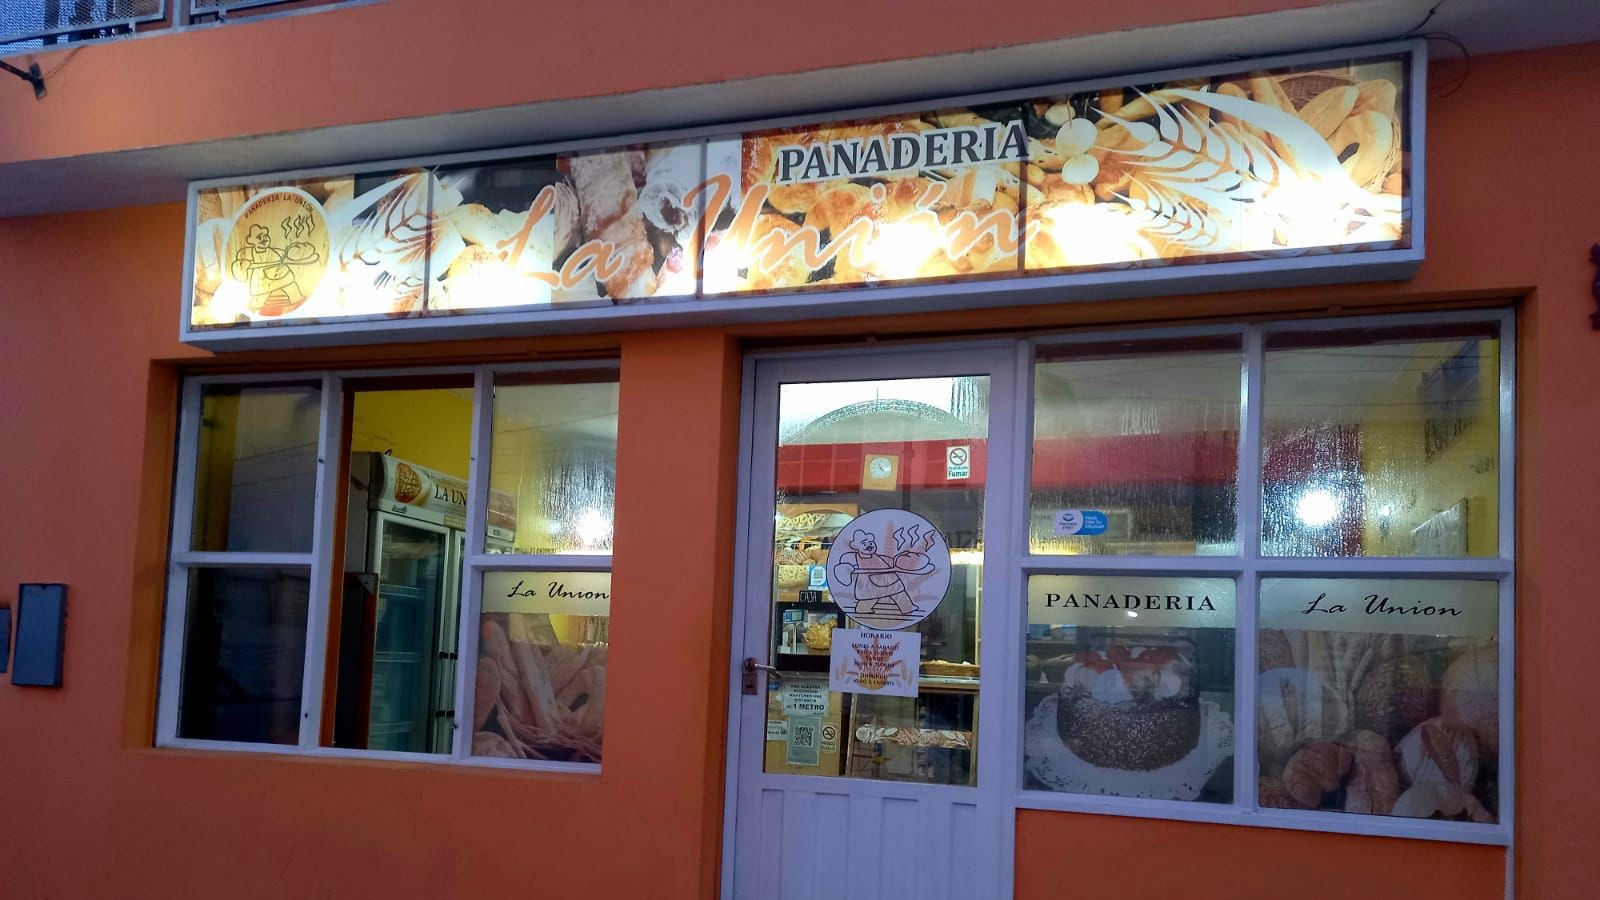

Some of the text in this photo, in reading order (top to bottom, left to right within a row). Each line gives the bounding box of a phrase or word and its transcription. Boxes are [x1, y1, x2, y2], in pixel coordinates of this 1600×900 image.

[780, 121, 1029, 182] PANADERIA
[283, 193, 292, 201] LA
[496, 185, 624, 288] La
[435, 484, 448, 502] LA
[506, 580, 610, 600] La Union
[800, 591, 817, 603] CAJA
[1045, 593, 1217, 611] PANADERIA
[1301, 592, 1463, 616] La Union
[798, 703, 825, 711] METRO
